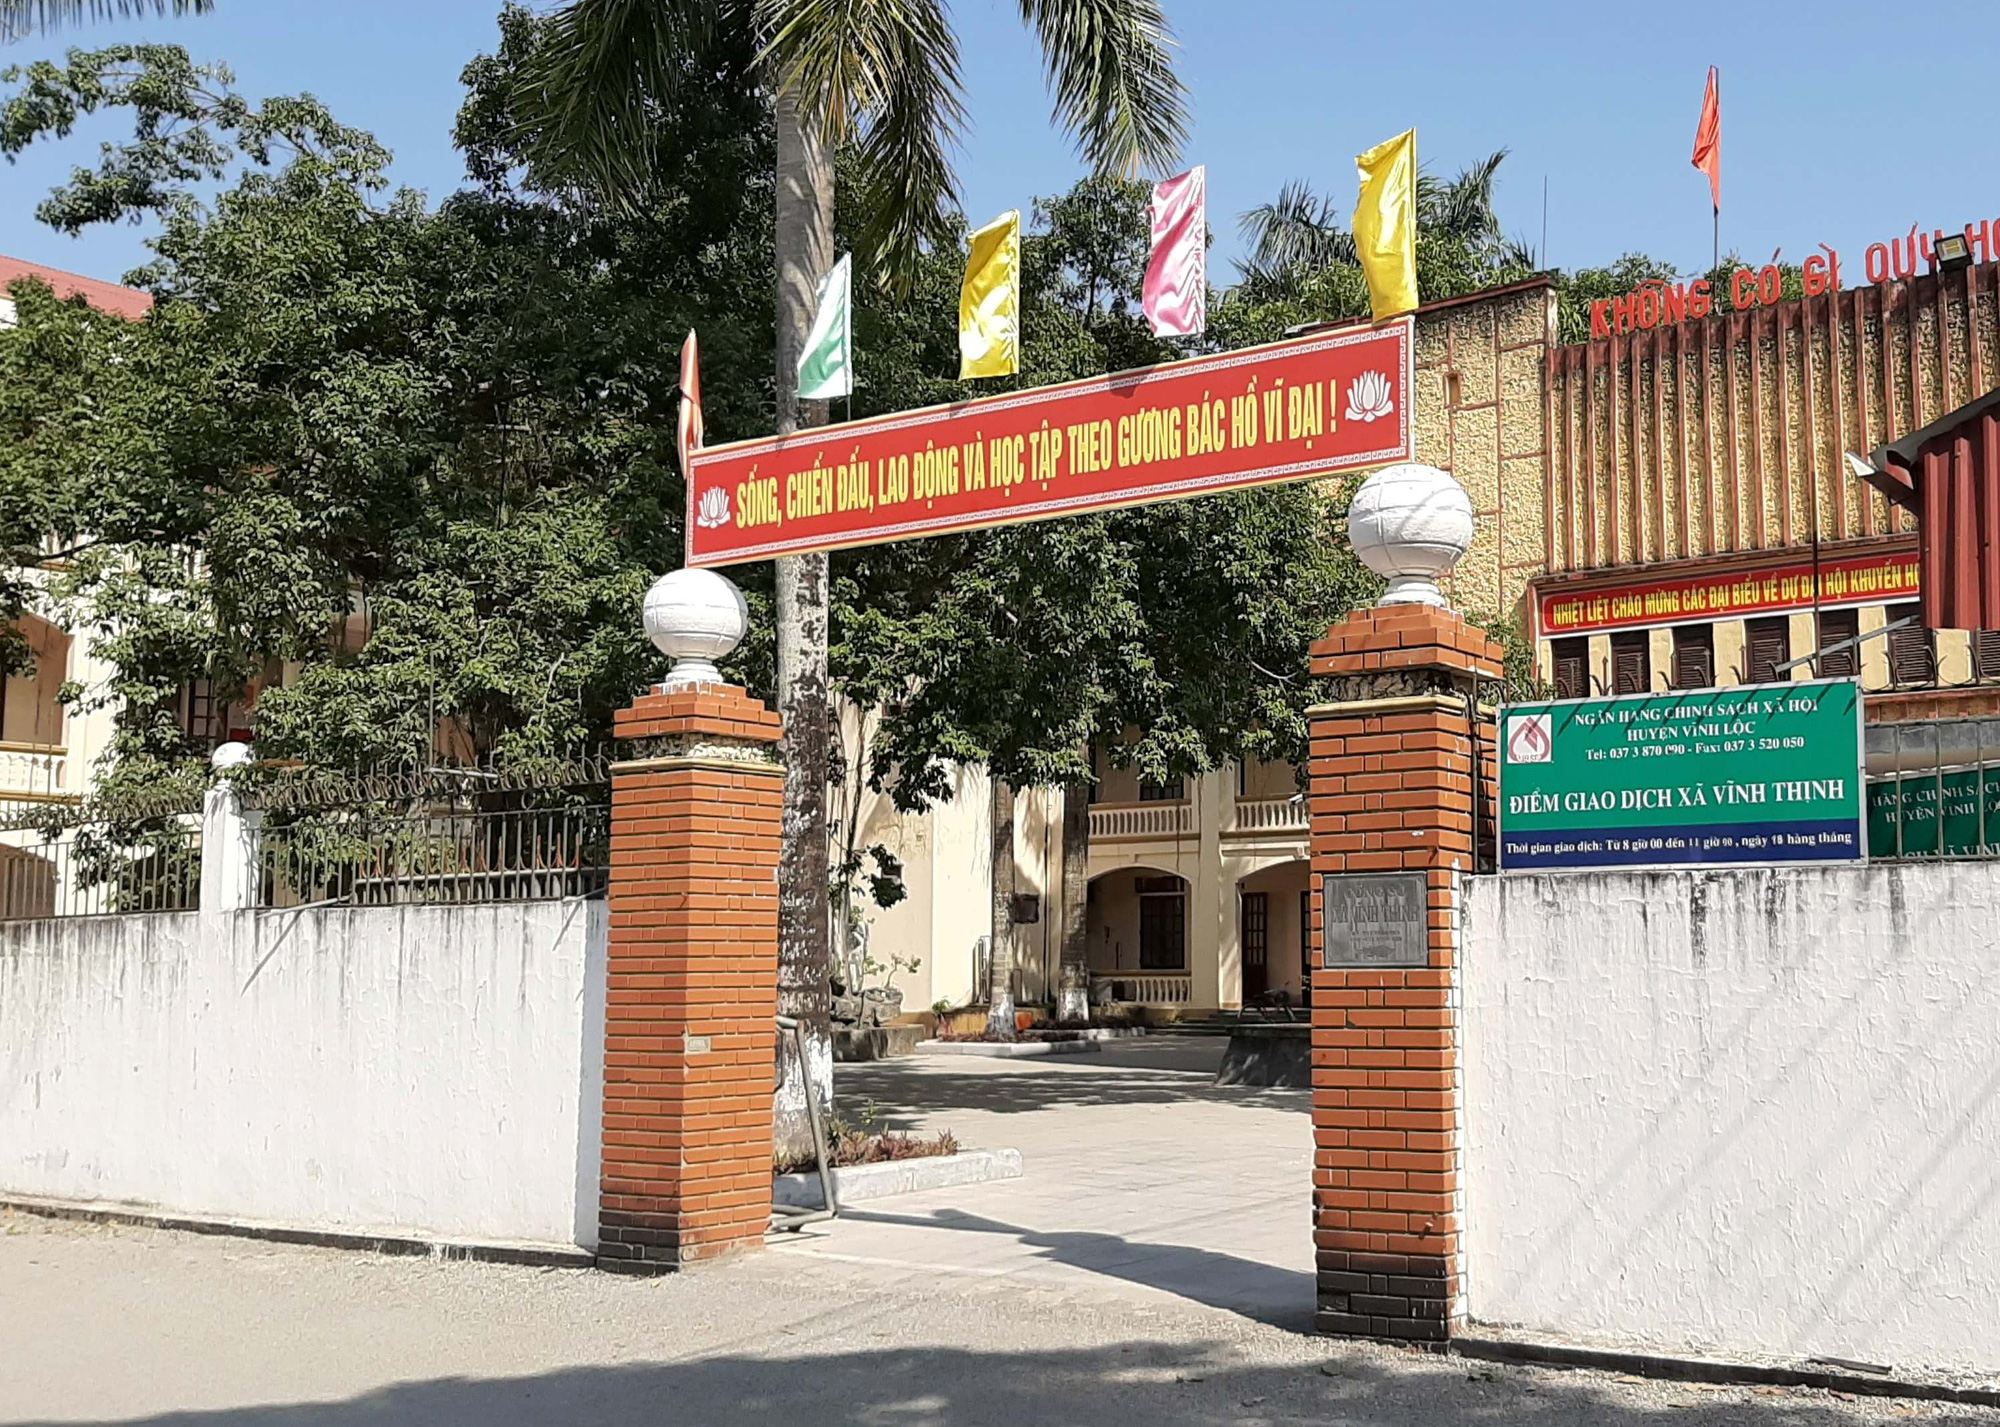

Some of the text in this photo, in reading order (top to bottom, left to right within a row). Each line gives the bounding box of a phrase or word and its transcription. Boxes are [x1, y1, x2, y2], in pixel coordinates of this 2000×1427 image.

[1590, 278, 1711, 340] KHÔNG
[1731, 247, 1782, 310] CÓ
[1802, 242, 1840, 296] GÌ
[736, 464, 782, 529] SỐNG,
[786, 452, 833, 520] CHIẾN
[837, 446, 874, 513] ĐẤU,
[878, 456, 908, 505] LAO
[913, 440, 958, 509] ĐỘNG
[963, 431, 985, 492] VÀ
[990, 434, 1025, 497] HỌC
[1029, 419, 1063, 491] TẬP
[1067, 421, 1112, 475] THEO
[1117, 406, 1182, 468] GƯƠNG
[1186, 391, 1226, 457] BÁC
[1231, 375, 1258, 449] HỒ
[1263, 377, 1283, 444] VĨ
[1288, 381, 1324, 449] ĐẠI
[1553, 598, 1584, 628] NHIỆT
[1587, 595, 1609, 625] LIỆT
[1612, 591, 1642, 619] CHÀO
[1645, 588, 1680, 615] MỪNG
[1683, 584, 1706, 611] CÁC
[1709, 585, 1730, 613] ĐẠI
[1732, 573, 1760, 606] BIỂU
[1763, 572, 1778, 602] VỀ
[1781, 574, 1799, 605] DỰ
[1825, 567, 1847, 600] HỘI
[1850, 559, 1902, 593] KHUYẾN
[1619, 706, 1661, 724] HÀNG
[1716, 699, 1758, 716] SÁCH
[1788, 695, 1818, 713] HỘI
[1627, 719, 1756, 743] HUYỆN VĨNH LỘC
[1585, 748, 1607, 760] Tel:
[1609, 746, 1629, 759] 037
[1632, 746, 1639, 758] 3
[1642, 745, 1662, 757] 870
[1724, 740, 1745, 752] 037
[1748, 739, 1755, 751] 3
[1758, 738, 1780, 750] 520
[1783, 736, 1804, 748] 050
[1510, 779, 1845, 814] ĐIỂM GIAO DỊCH XÃ VĨNH THỊNH
[1506, 842, 1528, 854] Thời
[1530, 843, 1552, 856] gian
[1554, 842, 1575, 855] giao
[1605, 839, 1621, 851] Từ
[1623, 839, 1629, 850] 8
[1632, 838, 1648, 852] giờ
[1650, 838, 1663, 849] 00
[1665, 835, 1685, 848] đến
[1703, 835, 1720, 850] giờ
[1741, 835, 1768, 849] ngày
[1787, 832, 1816, 846] hàng
[1818, 831, 1852, 845] tháng
